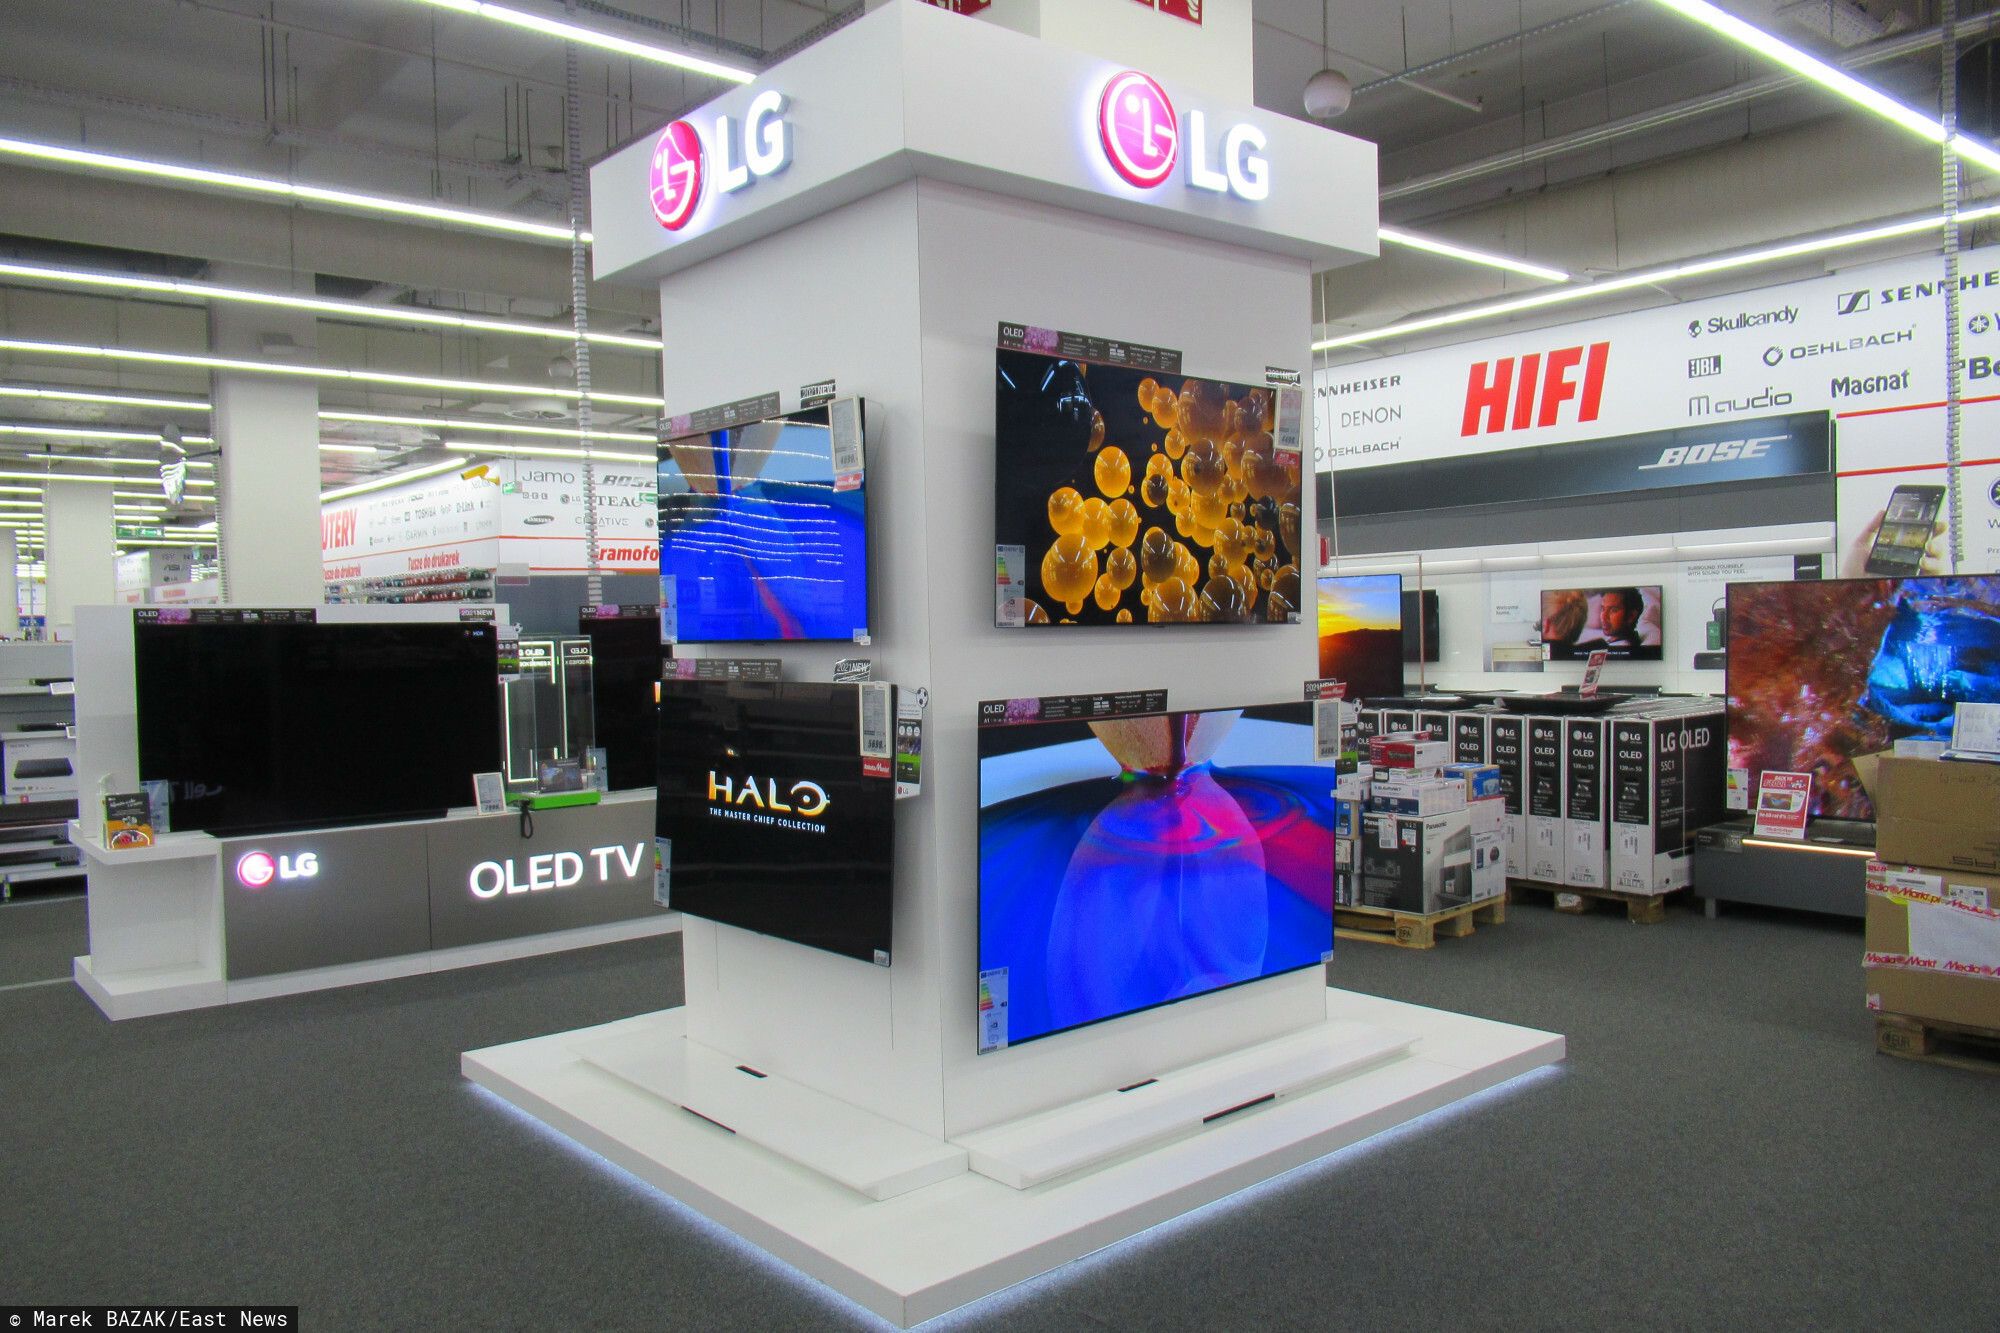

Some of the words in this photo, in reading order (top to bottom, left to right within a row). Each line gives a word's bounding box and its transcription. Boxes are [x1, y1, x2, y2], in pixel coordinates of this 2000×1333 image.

[715, 90, 792, 194] LG
[1182, 110, 1271, 199] LG
[1707, 304, 1799, 334] Skullcandy
[1003, 326, 1024, 338] OLED
[1790, 328, 1913, 360] OEHLBACH
[1688, 354, 1722, 379] JBL
[1460, 341, 1611, 437] HIFI
[1830, 369, 1911, 399] Magnat
[1341, 404, 1402, 428] DENON
[1327, 440, 1400, 459] OEHLBACH
[1638, 434, 1789, 470] BOSE
[522, 470, 575, 484] Jamo
[983, 704, 1005, 714] OLED
[1468, 726, 1478, 734] LG
[1543, 730, 1554, 738] LG
[1582, 731, 1593, 740] LG
[1629, 732, 1641, 741] LG
[1459, 742, 1479, 751] OLED
[1496, 746, 1516, 754] OLED
[1660, 732, 1676, 753] LG
[1679, 728, 1710, 750] OLED
[1534, 747, 1555, 756] OLED
[1572, 750, 1594, 758] OLED
[1619, 751, 1643, 759] OLED
[708, 770, 831, 817] HALO
[709, 807, 722, 817] THE
[724, 809, 751, 821] MASTER
[753, 813, 775, 825] CHIEF
[778, 818, 826, 833] COLLECTION
[1426, 821, 1448, 831] Panasonic
[279, 852, 319, 879] LG
[469, 849, 584, 899] OLED
[590, 842, 645, 881] TV
[1903, 956, 1938, 968] Markt
